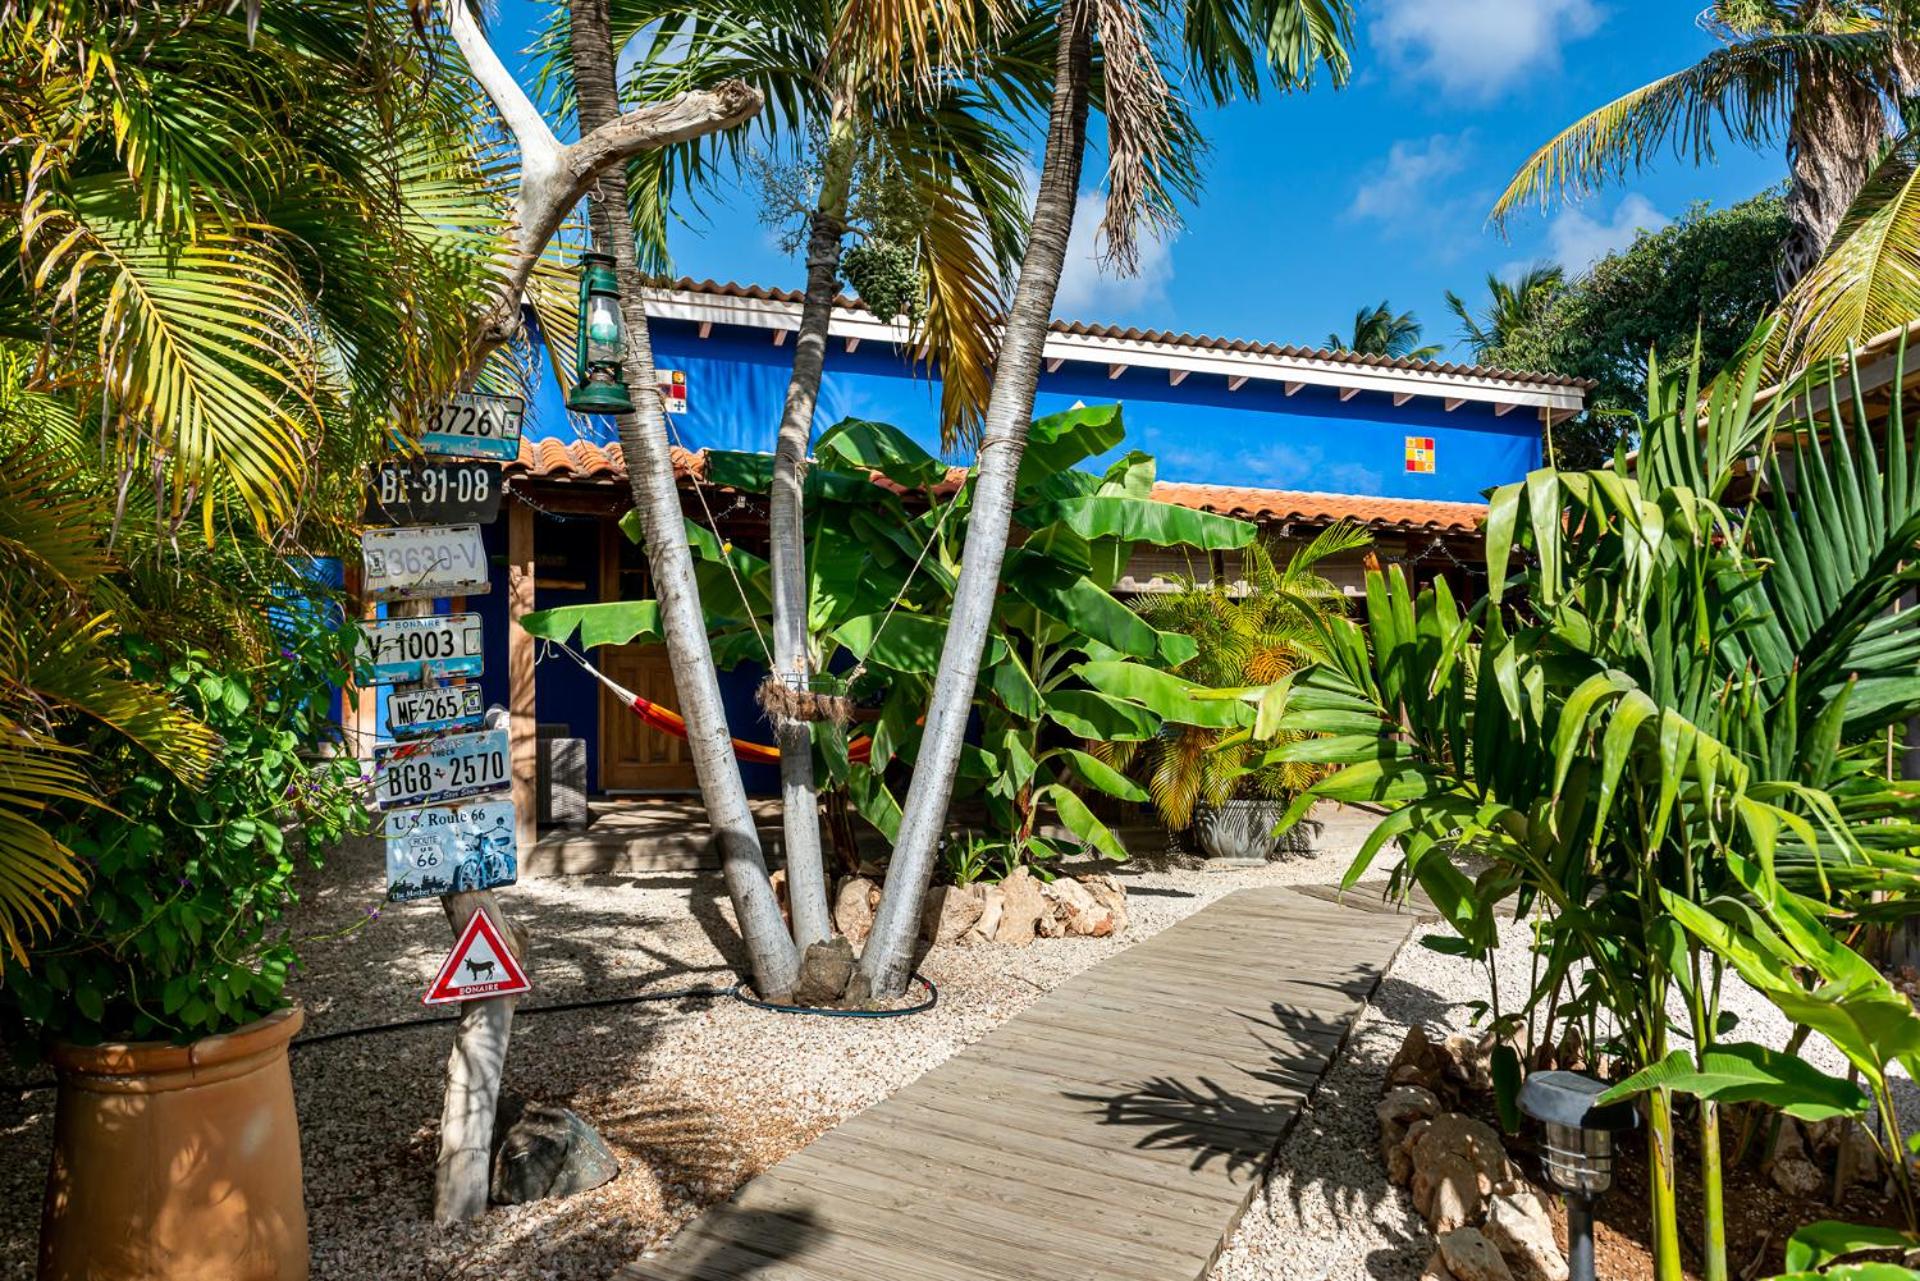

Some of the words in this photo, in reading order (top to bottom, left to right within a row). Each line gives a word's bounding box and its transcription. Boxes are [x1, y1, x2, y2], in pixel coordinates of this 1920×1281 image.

[397, 695, 458, 724] MF-265
[388, 761, 432, 796] BG8
[450, 750, 504, 786] 2570
[428, 812, 468, 827] Route
[471, 808, 486, 821] 66
[416, 852, 438, 868] 66
[459, 983, 499, 996] BONAIRE
